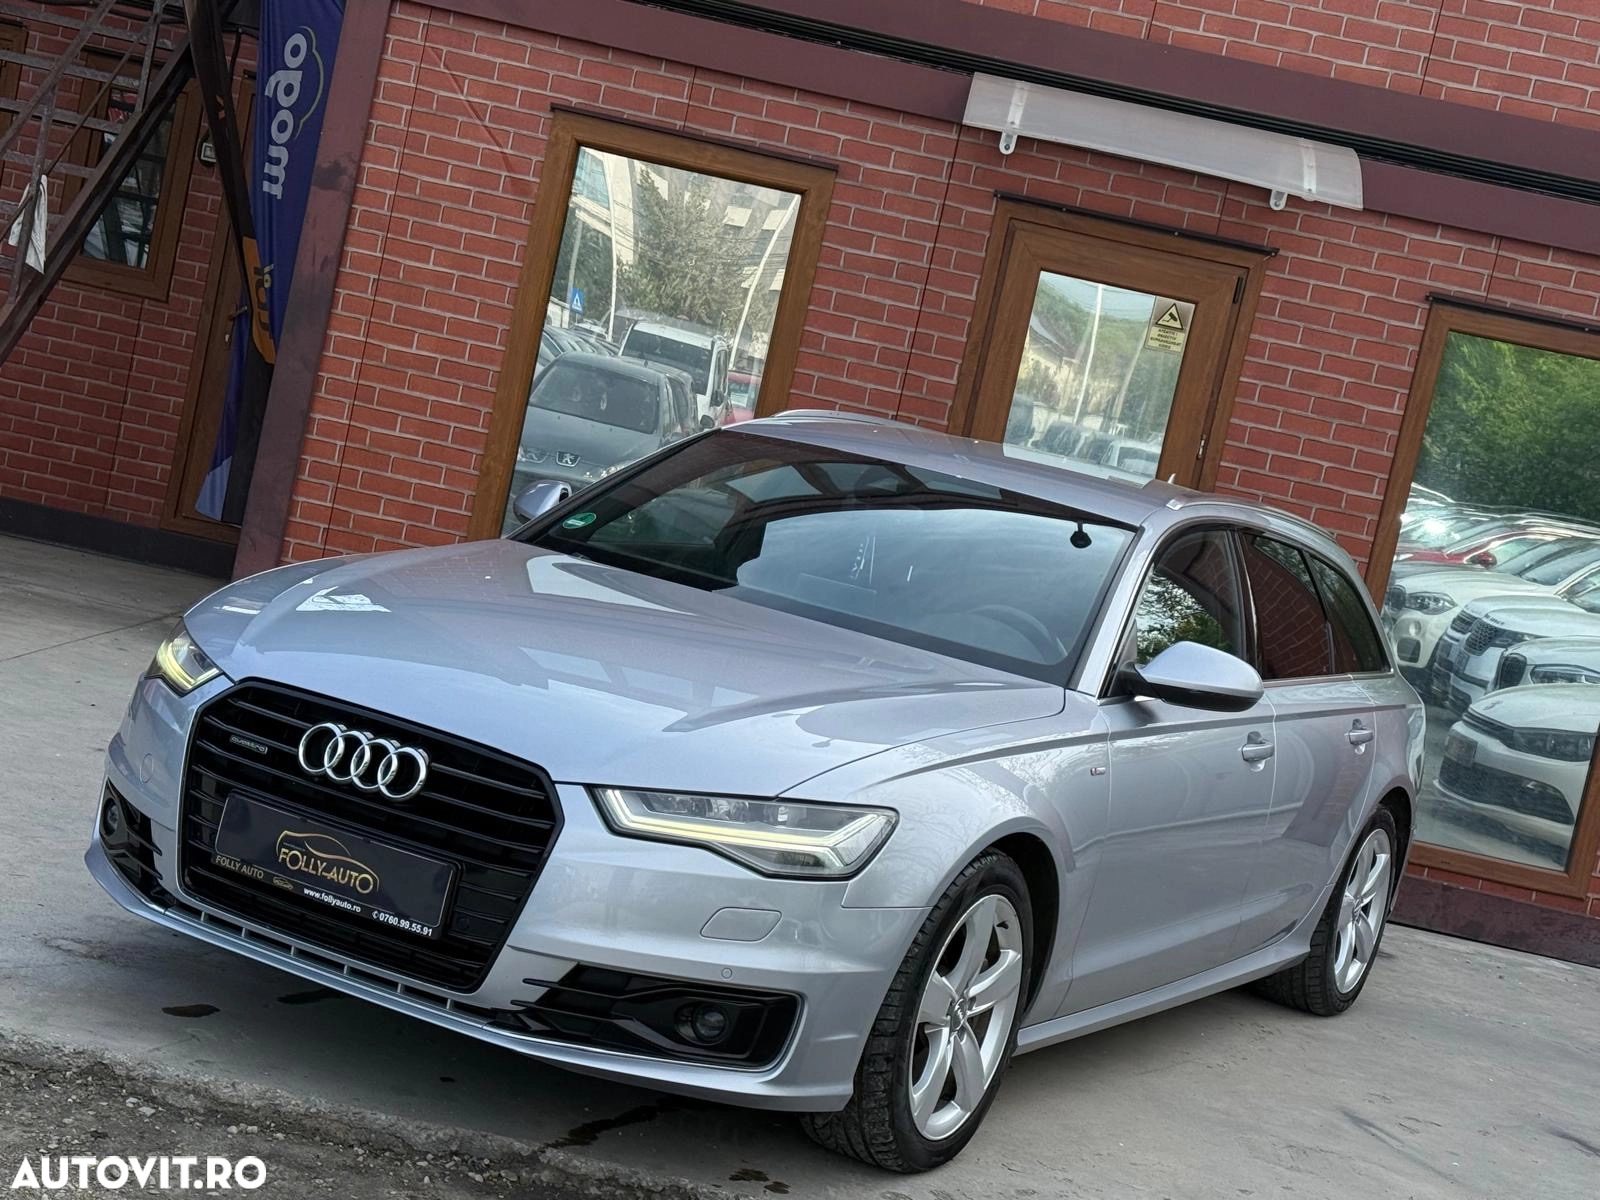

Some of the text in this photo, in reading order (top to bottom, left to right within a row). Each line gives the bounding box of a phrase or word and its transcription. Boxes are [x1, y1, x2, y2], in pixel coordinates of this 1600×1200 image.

[215, 855, 264, 879] FOLLY AUTO
[303, 887, 361, 913] www.follyauto.ro
[379, 912, 433, 937] 0760.99.55.91
